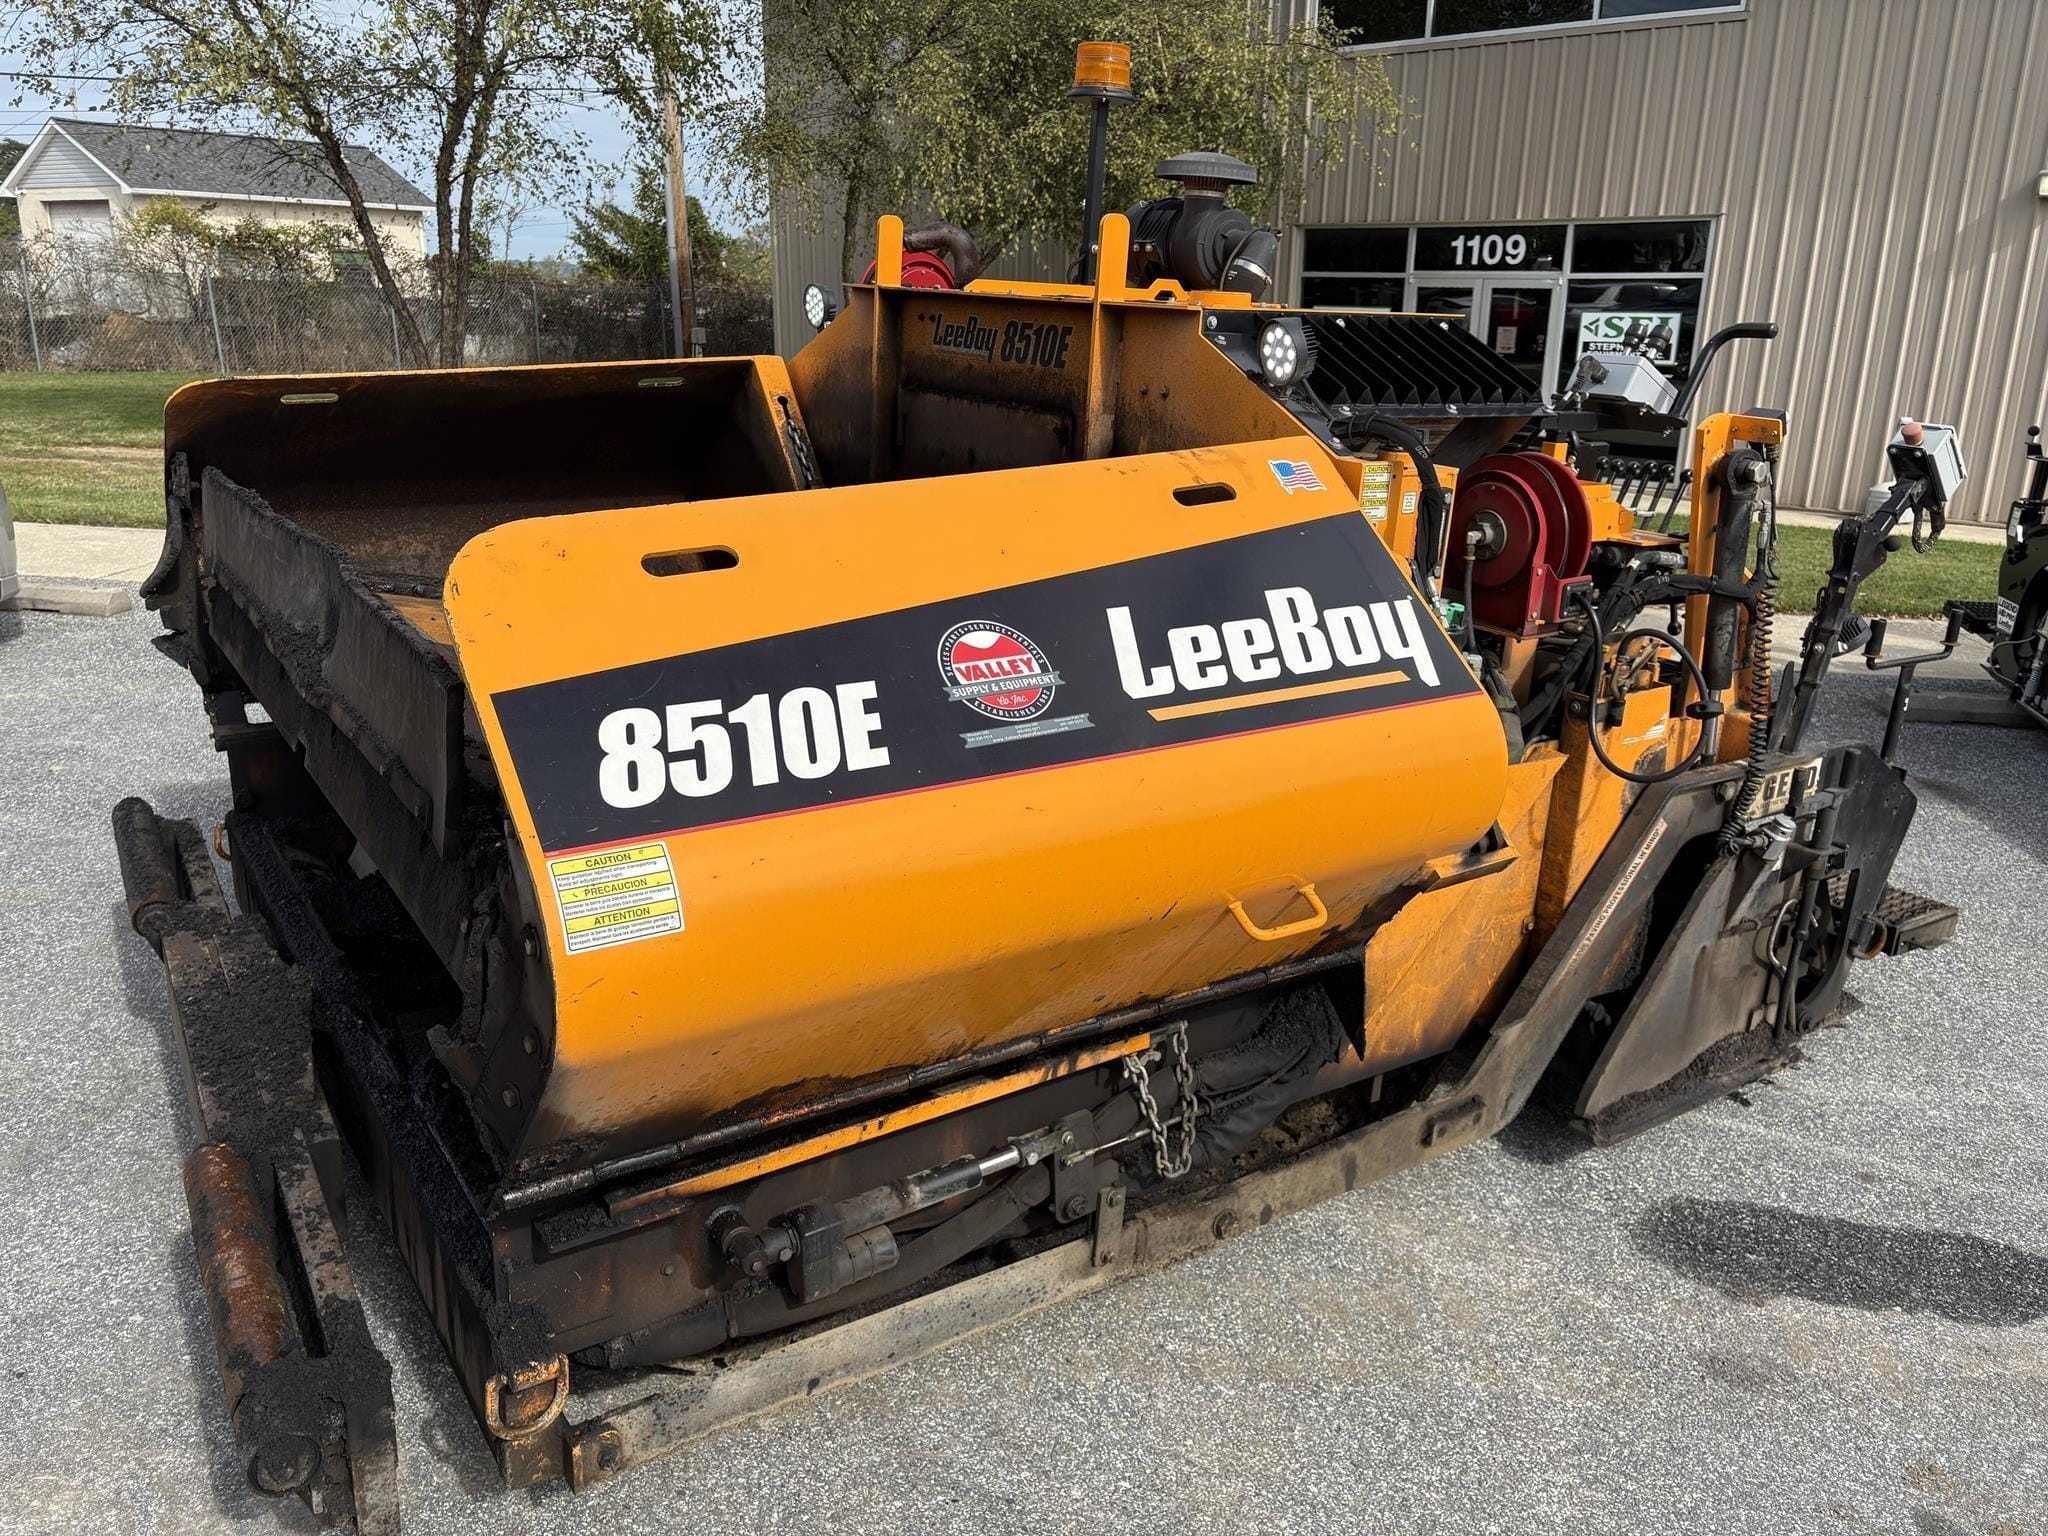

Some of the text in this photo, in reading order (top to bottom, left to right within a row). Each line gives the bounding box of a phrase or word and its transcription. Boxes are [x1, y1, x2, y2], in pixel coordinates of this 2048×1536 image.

[1451, 234, 1527, 265] 1109
[934, 313, 1072, 369] LeeBoy 8510E
[943, 623, 1045, 676] SALES PARTS SERVICE RENTALS
[1106, 587, 1440, 699] LeeBoy
[955, 656, 1036, 682] VALLEY
[952, 674, 1055, 697] SUPPLY & EQUIPMENT
[974, 700, 1036, 718] ESTABLISHED
[598, 680, 890, 808] 8510E
[585, 852, 632, 868] CAUTION
[584, 878, 648, 897] PRECAUCION
[1585, 913, 1606, 943] PAVING
[1603, 860, 1641, 915] PROFESSIONAL
[1637, 850, 1646, 860] IN
[594, 906, 651, 926] ATTENTION
